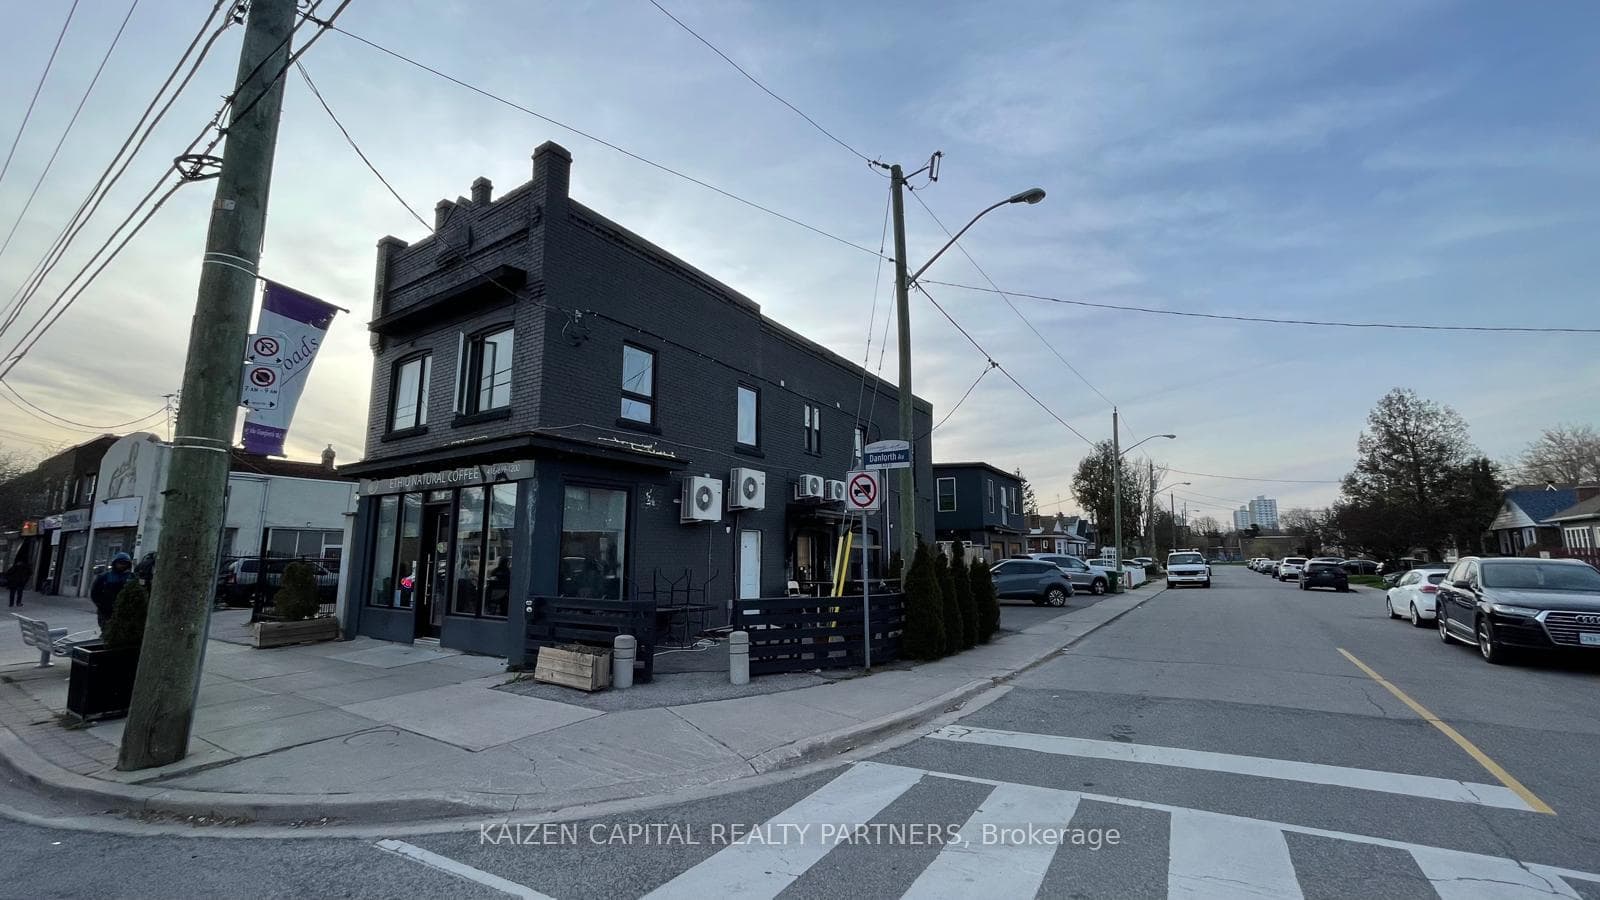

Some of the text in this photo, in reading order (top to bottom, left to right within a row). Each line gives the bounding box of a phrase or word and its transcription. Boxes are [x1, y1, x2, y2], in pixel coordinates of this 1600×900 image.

[282, 335, 319, 371] oads
[869, 452, 897, 463] Danforth
[389, 477, 409, 489] ETHIO
[411, 471, 446, 487] NATURAL
[447, 467, 479, 483] COFFEE
